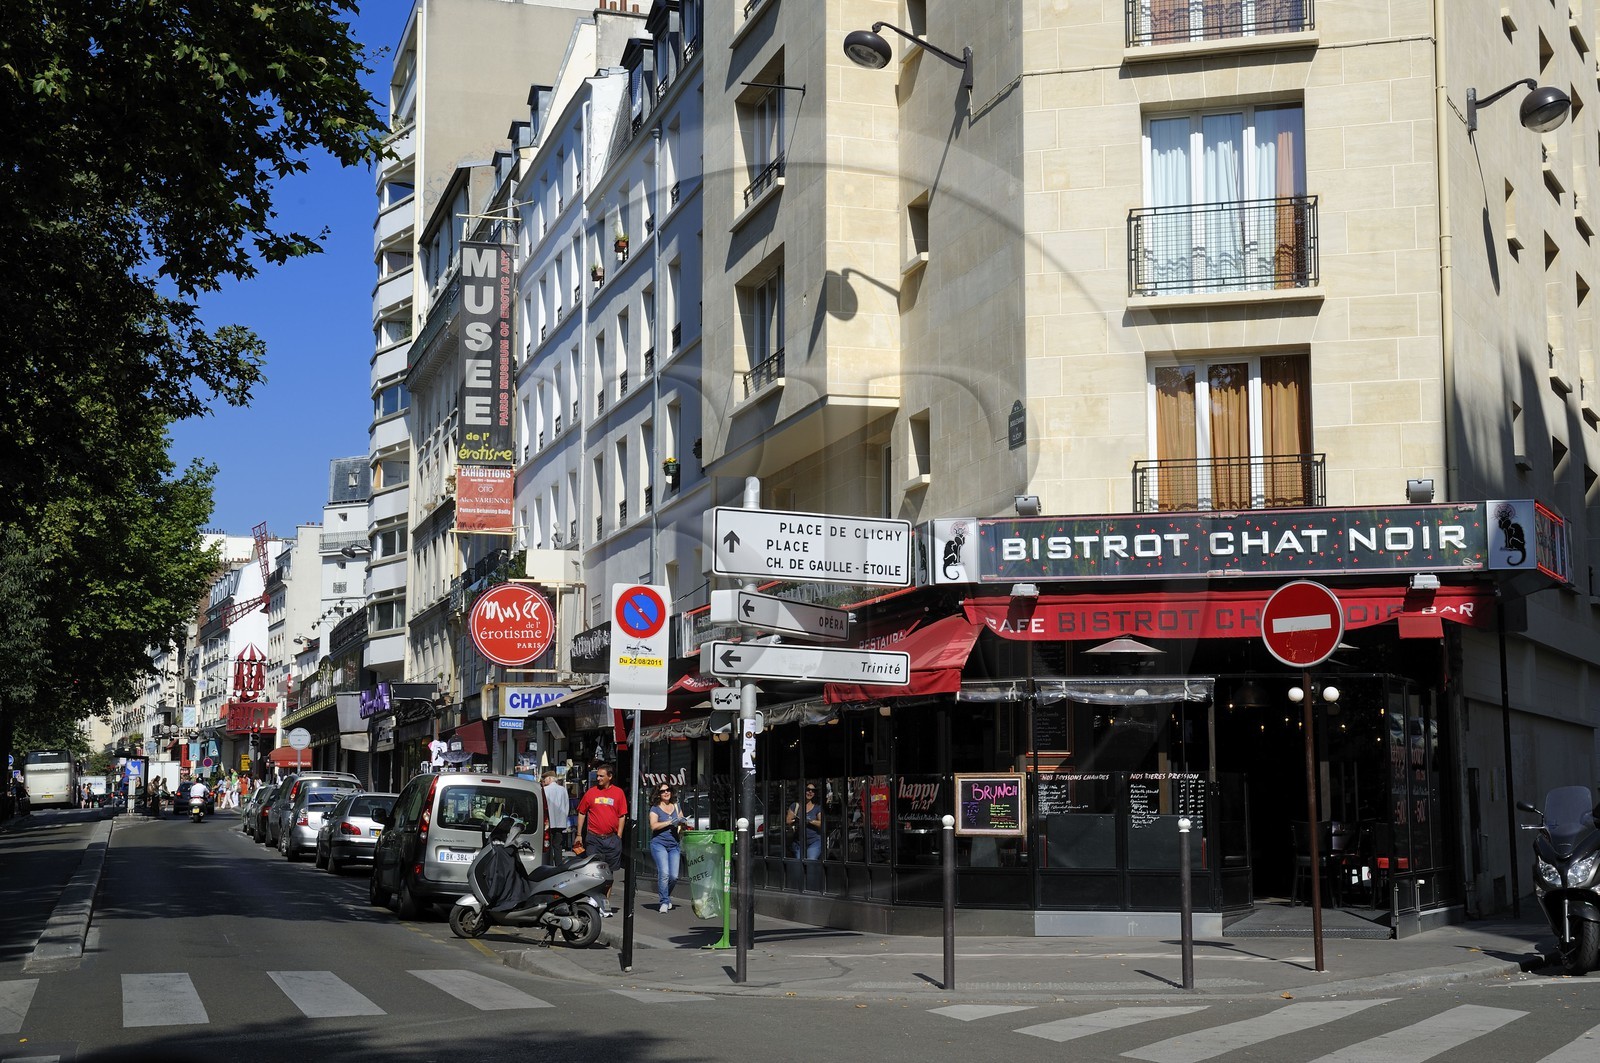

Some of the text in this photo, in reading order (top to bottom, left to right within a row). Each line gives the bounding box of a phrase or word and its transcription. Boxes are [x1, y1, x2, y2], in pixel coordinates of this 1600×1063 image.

[500, 276, 510, 319] EROTIC
[462, 248, 496, 426] MUSEE
[500, 321, 510, 337] OF
[499, 339, 509, 390] MUSEUM
[499, 392, 508, 426] PARIS
[466, 432, 480, 440] de
[458, 443, 512, 460] érotisme
[461, 468, 511, 478] EXHIBITIONS
[780, 522, 902, 542] PLACE DE CLICHY
[766, 540, 809, 552] PLACE
[1002, 524, 1468, 562] BISTROT CHAT NOIR
[766, 557, 784, 569] CH.
[789, 559, 804, 570] DE
[480, 594, 541, 624] Musée
[984, 602, 1475, 634] CAFE BISTROT CH OIR BAR
[480, 627, 542, 640] érotisme
[818, 616, 844, 631] OPÉRA
[860, 662, 901, 676] Trinité
[898, 776, 940, 804] happy
[972, 782, 1018, 806] BRUNCH
